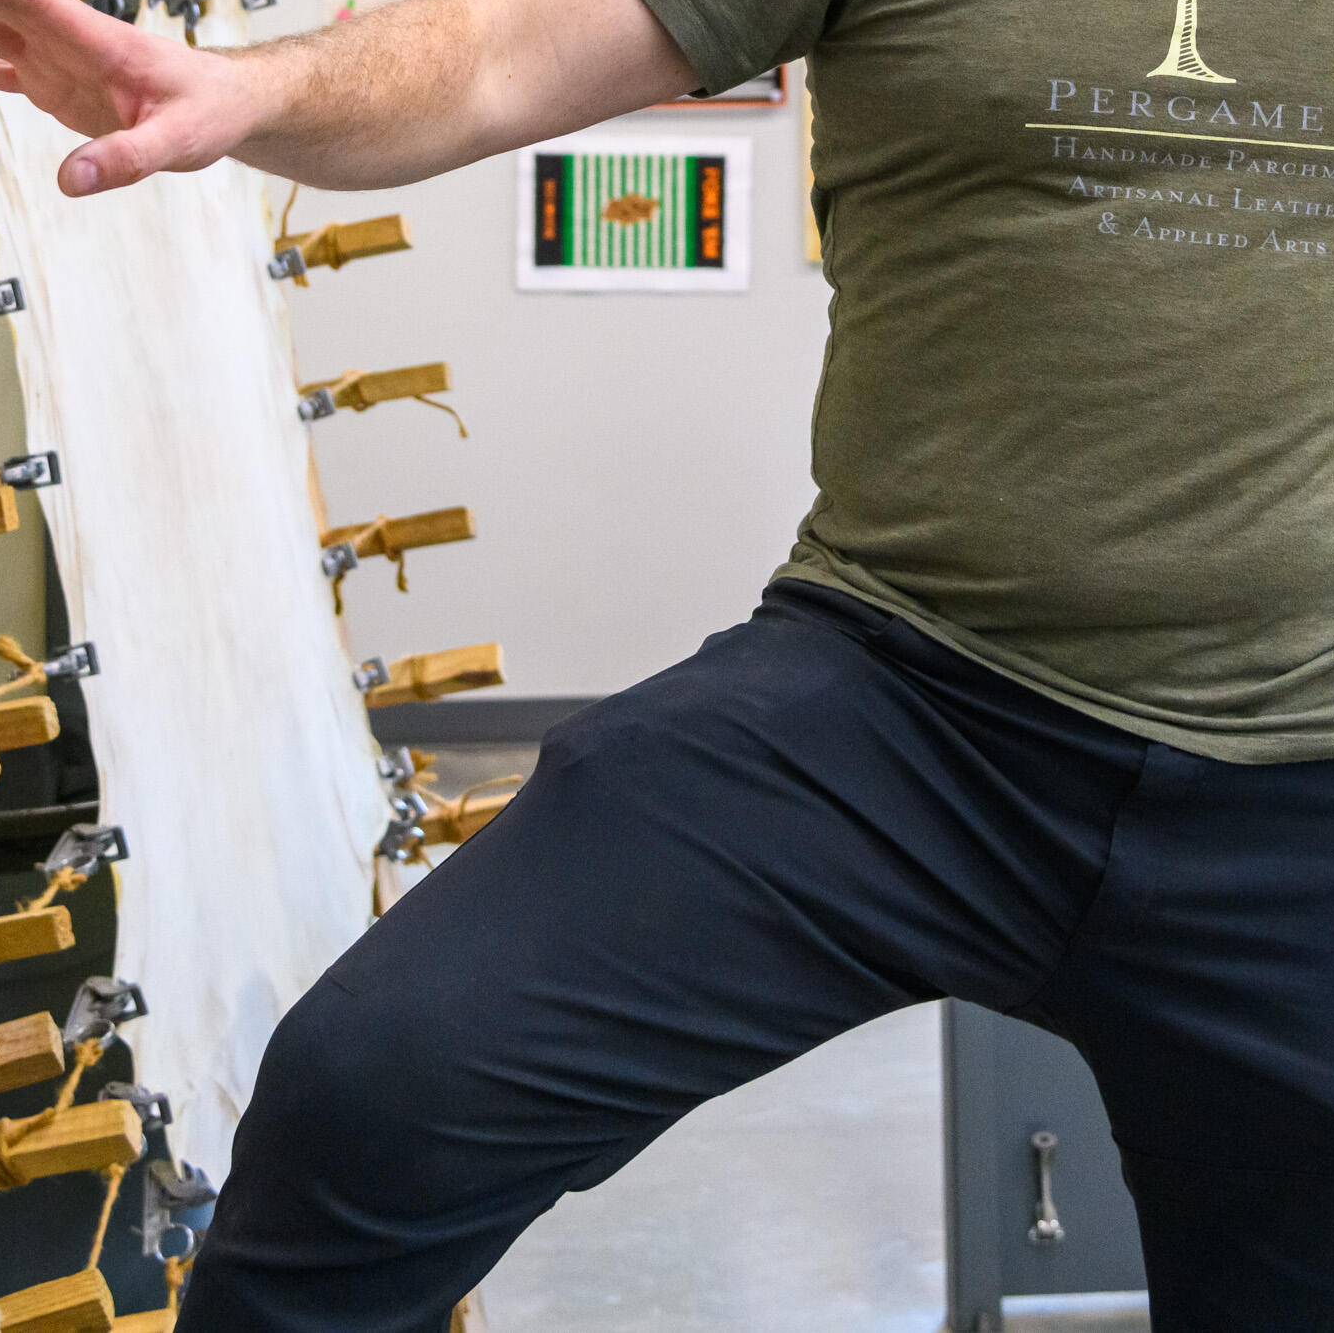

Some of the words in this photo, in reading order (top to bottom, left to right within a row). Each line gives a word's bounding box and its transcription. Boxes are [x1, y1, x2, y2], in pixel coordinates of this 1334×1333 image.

[1052, 135, 1213, 170] HANDMADE
[1067, 175, 1220, 209] ARTISANAL
[1097, 210, 1120, 235] &
[1132, 216, 1249, 250] APPLIED
[1259, 229, 1328, 256] ARTS
